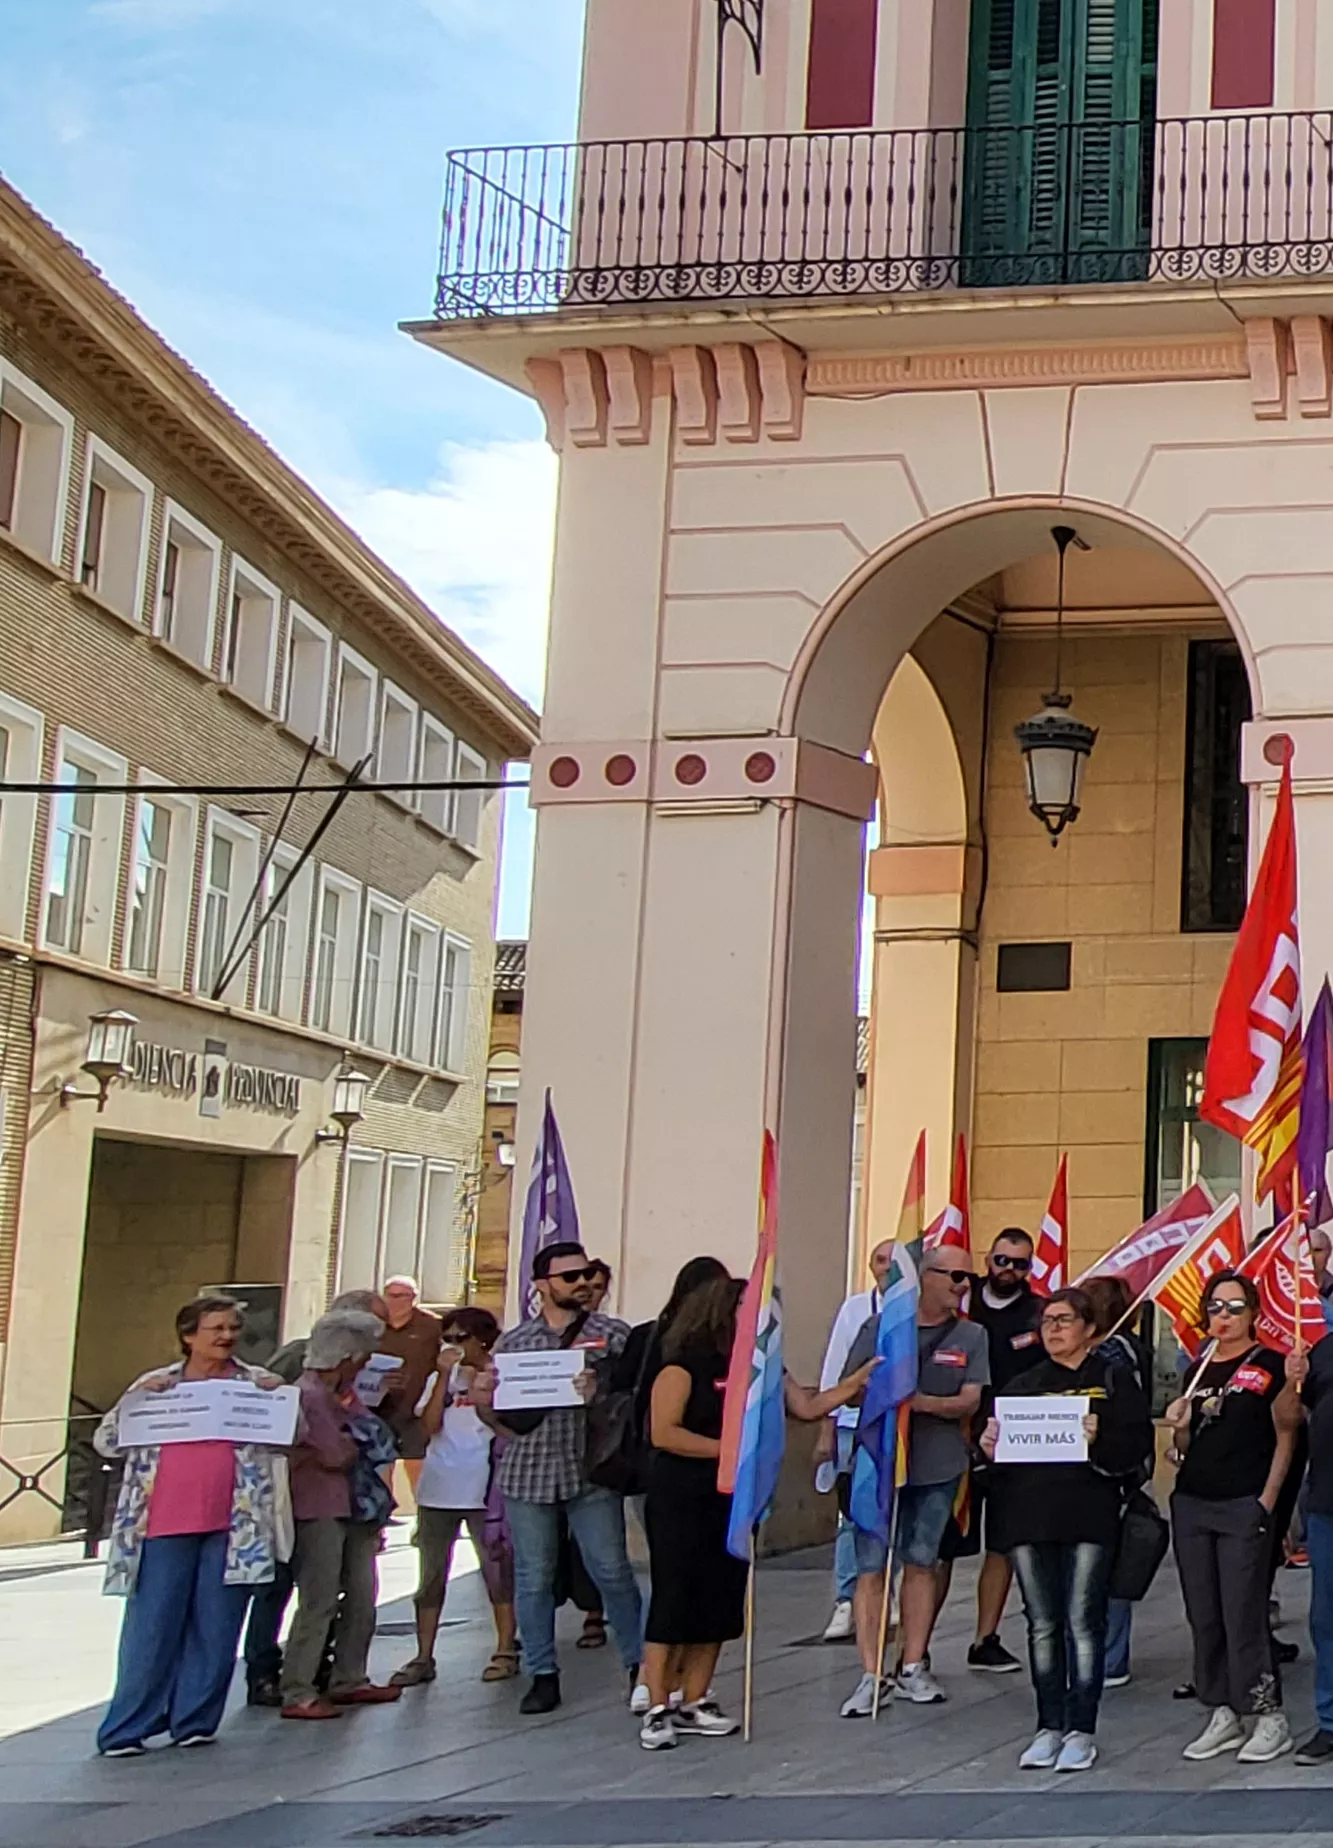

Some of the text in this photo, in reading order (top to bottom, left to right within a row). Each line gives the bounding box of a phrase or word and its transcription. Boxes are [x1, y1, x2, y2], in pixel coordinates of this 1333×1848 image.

[131, 1040, 198, 1094] DIENCIA
[1007, 1430, 1077, 1445] VIVIR MÁS
